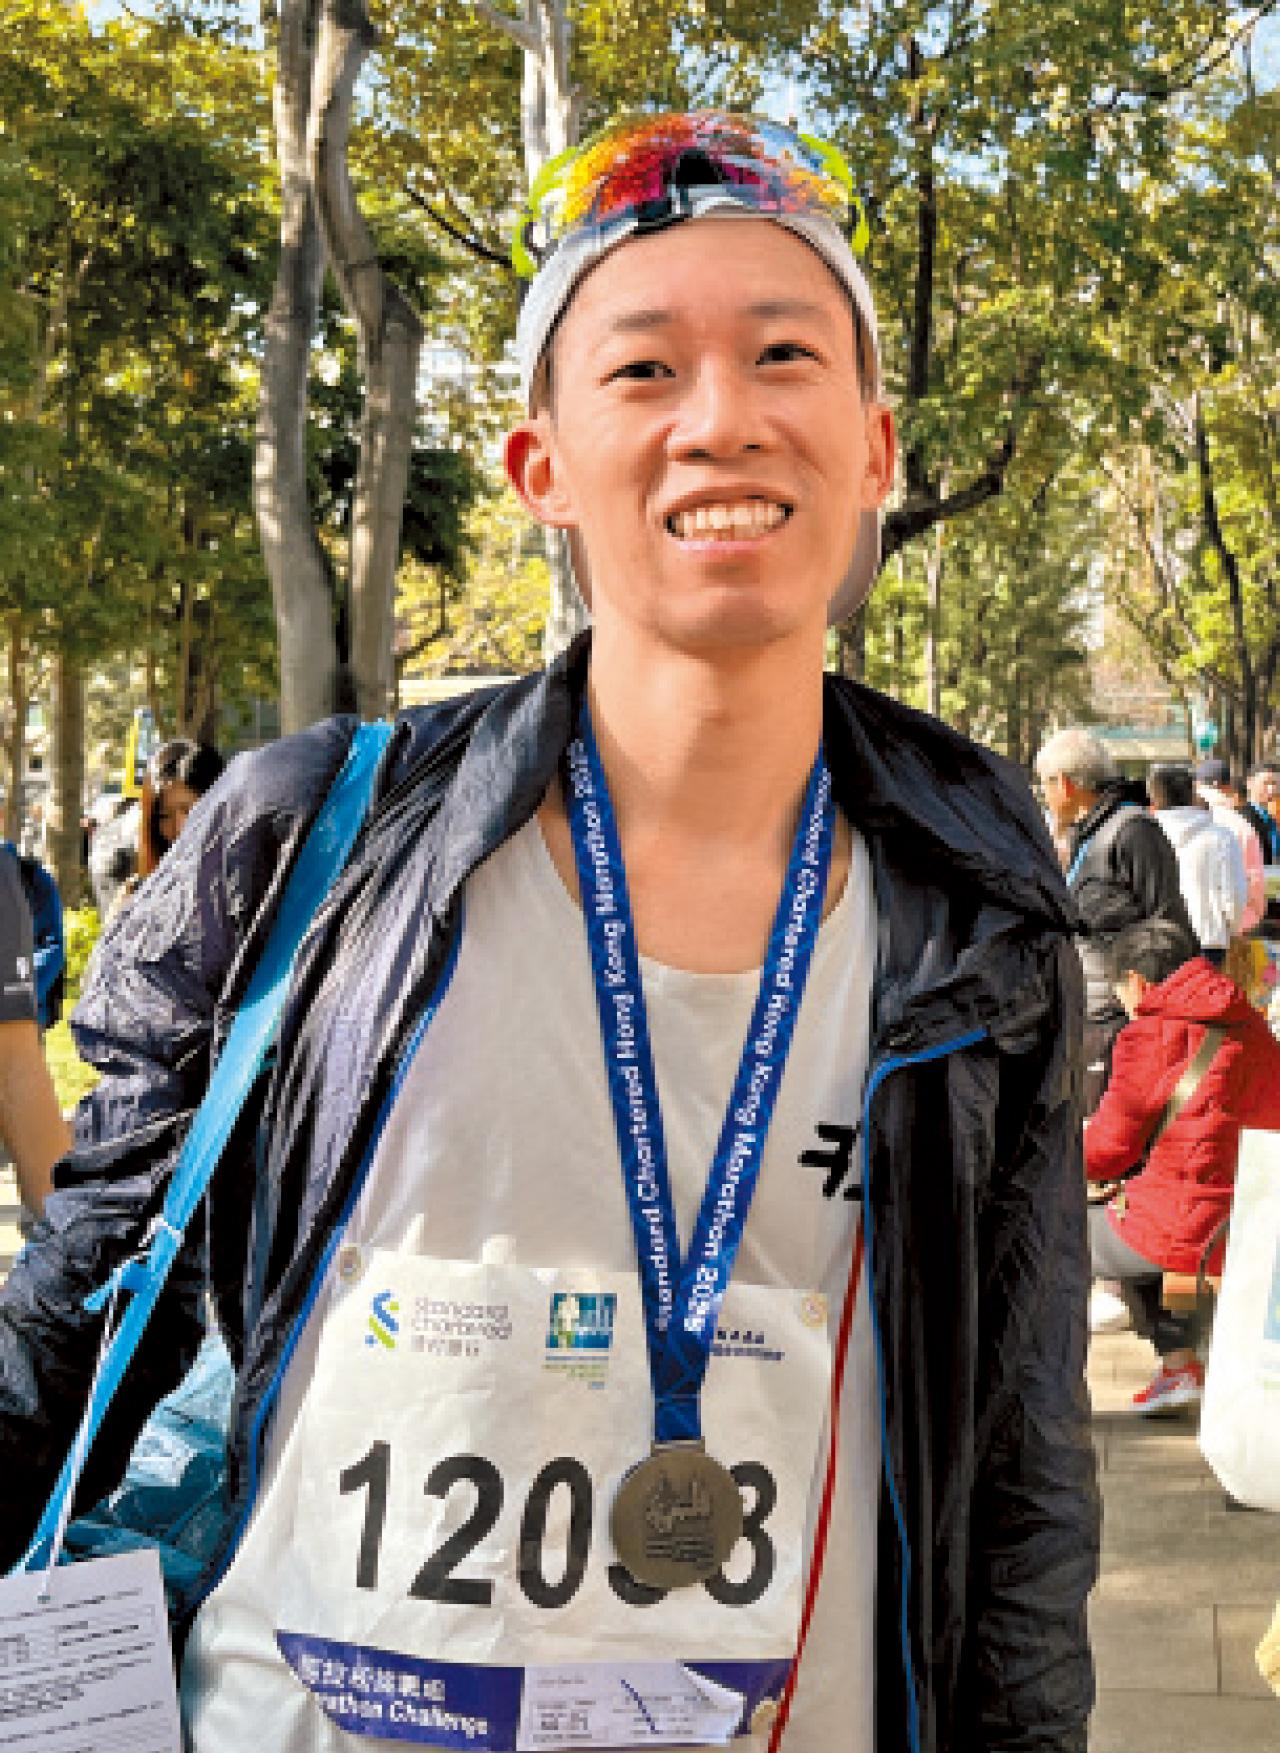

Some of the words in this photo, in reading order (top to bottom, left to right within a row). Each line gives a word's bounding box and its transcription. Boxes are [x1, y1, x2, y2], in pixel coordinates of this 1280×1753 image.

[584, 802, 617, 915] Marathon
[604, 921, 626, 986] Kong
[776, 869, 820, 987] Chartered
[613, 995, 637, 1058] Hong
[756, 994, 788, 1057] Hong
[621, 1066, 660, 1201] Chartered
[735, 1062, 772, 1125] Kong
[705, 1133, 757, 1258] Marathon
[340, 1440, 777, 1609] 1203
[389, 1700, 488, 1740] Challenge
